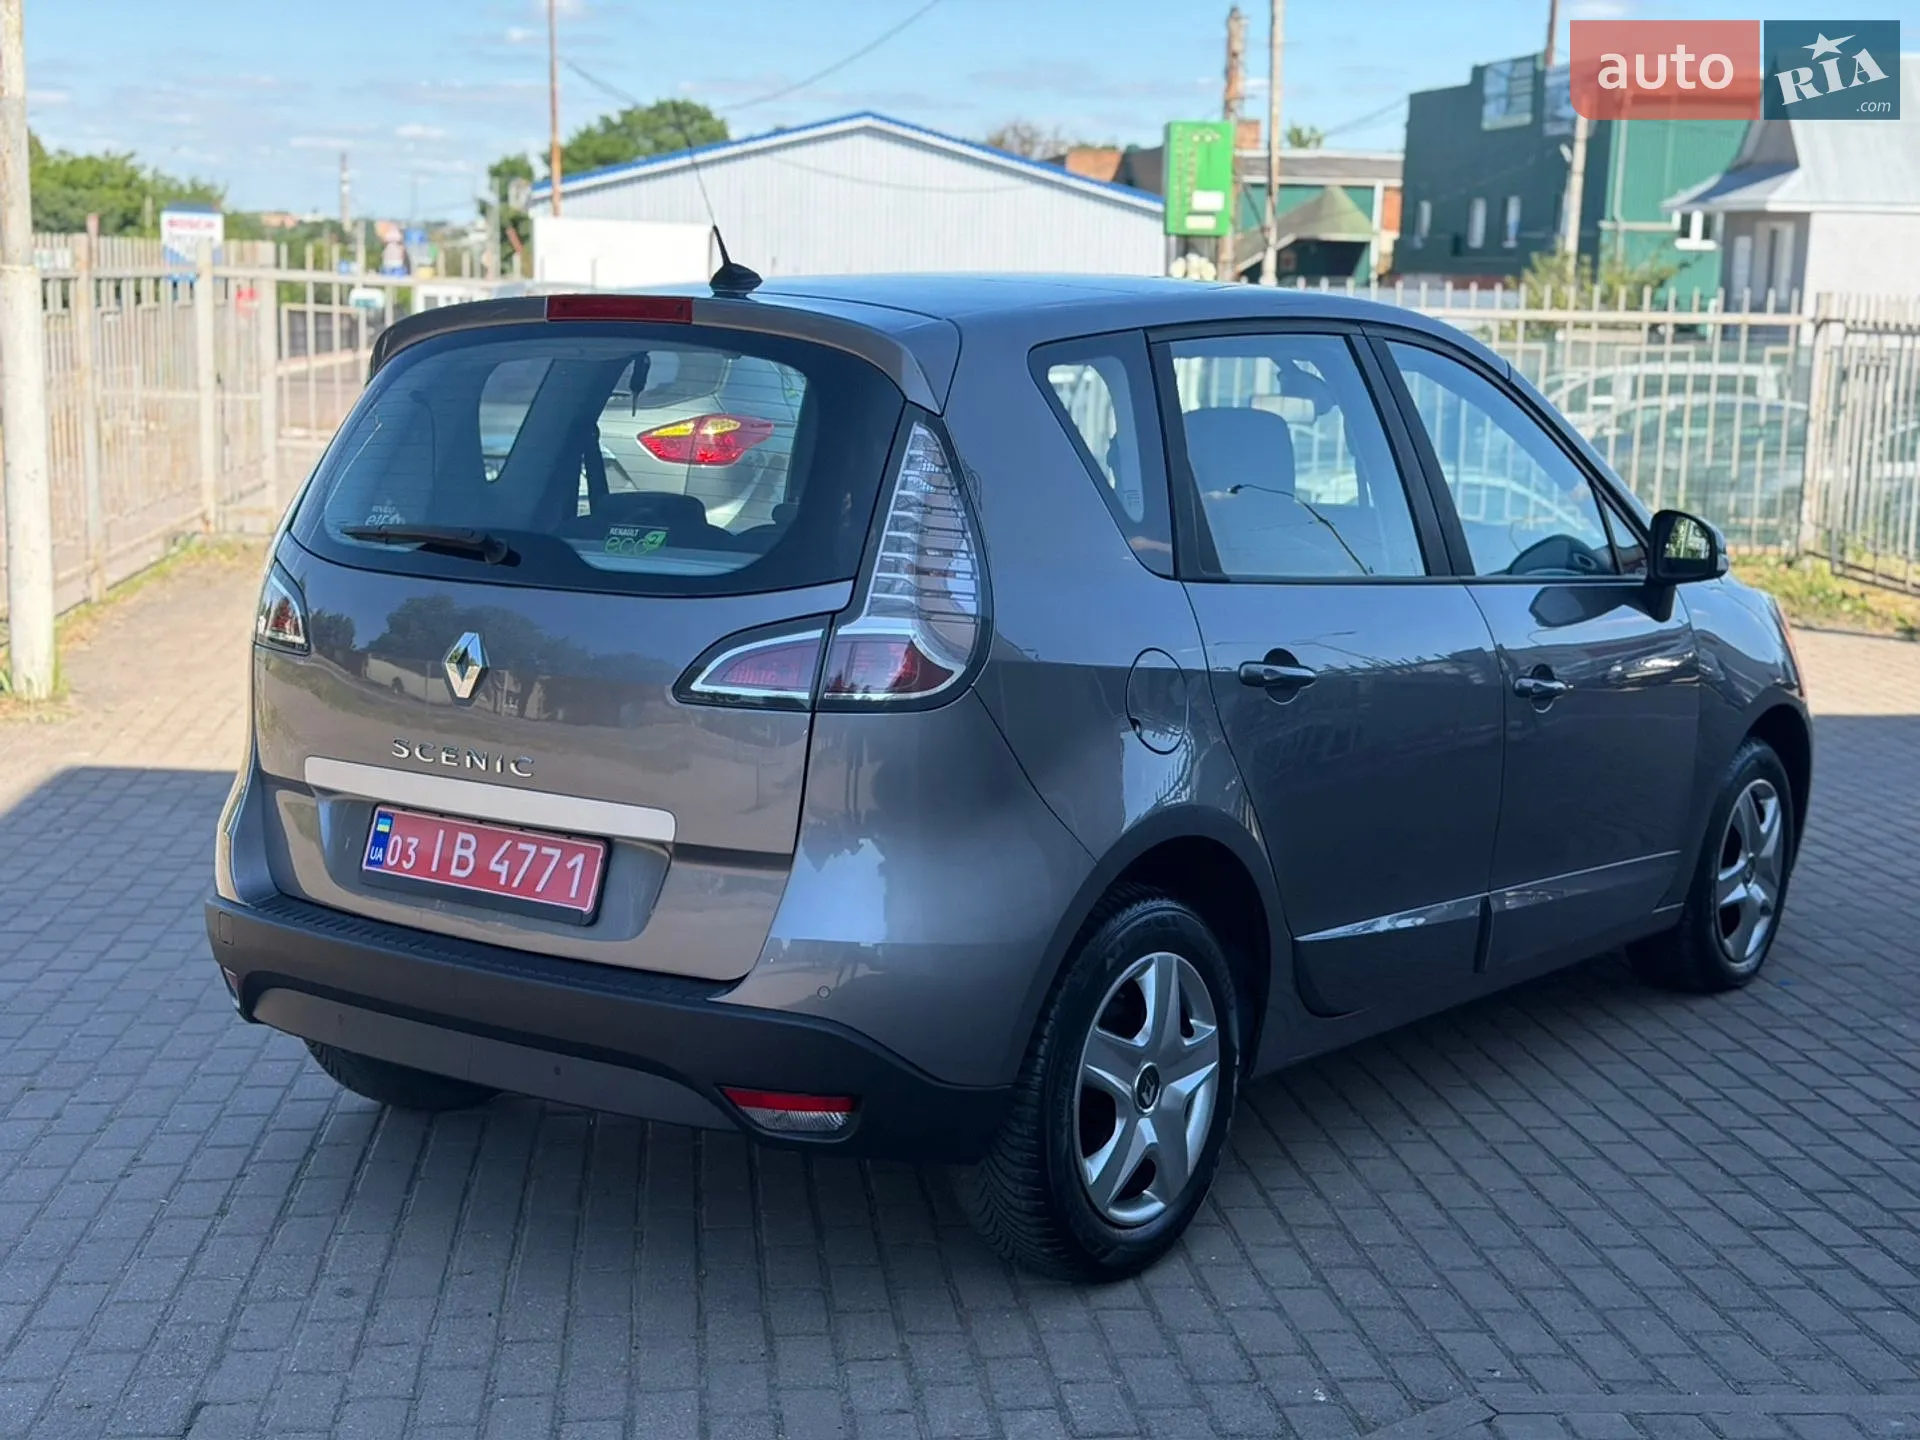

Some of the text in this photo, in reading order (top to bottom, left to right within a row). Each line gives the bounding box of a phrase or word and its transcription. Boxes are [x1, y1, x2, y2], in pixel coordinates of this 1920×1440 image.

[609, 527, 640, 537] RENAULT
[391, 737, 535, 778] SCENIC
[369, 846, 384, 862] UA
[386, 828, 586, 899] 03 IB 4771
